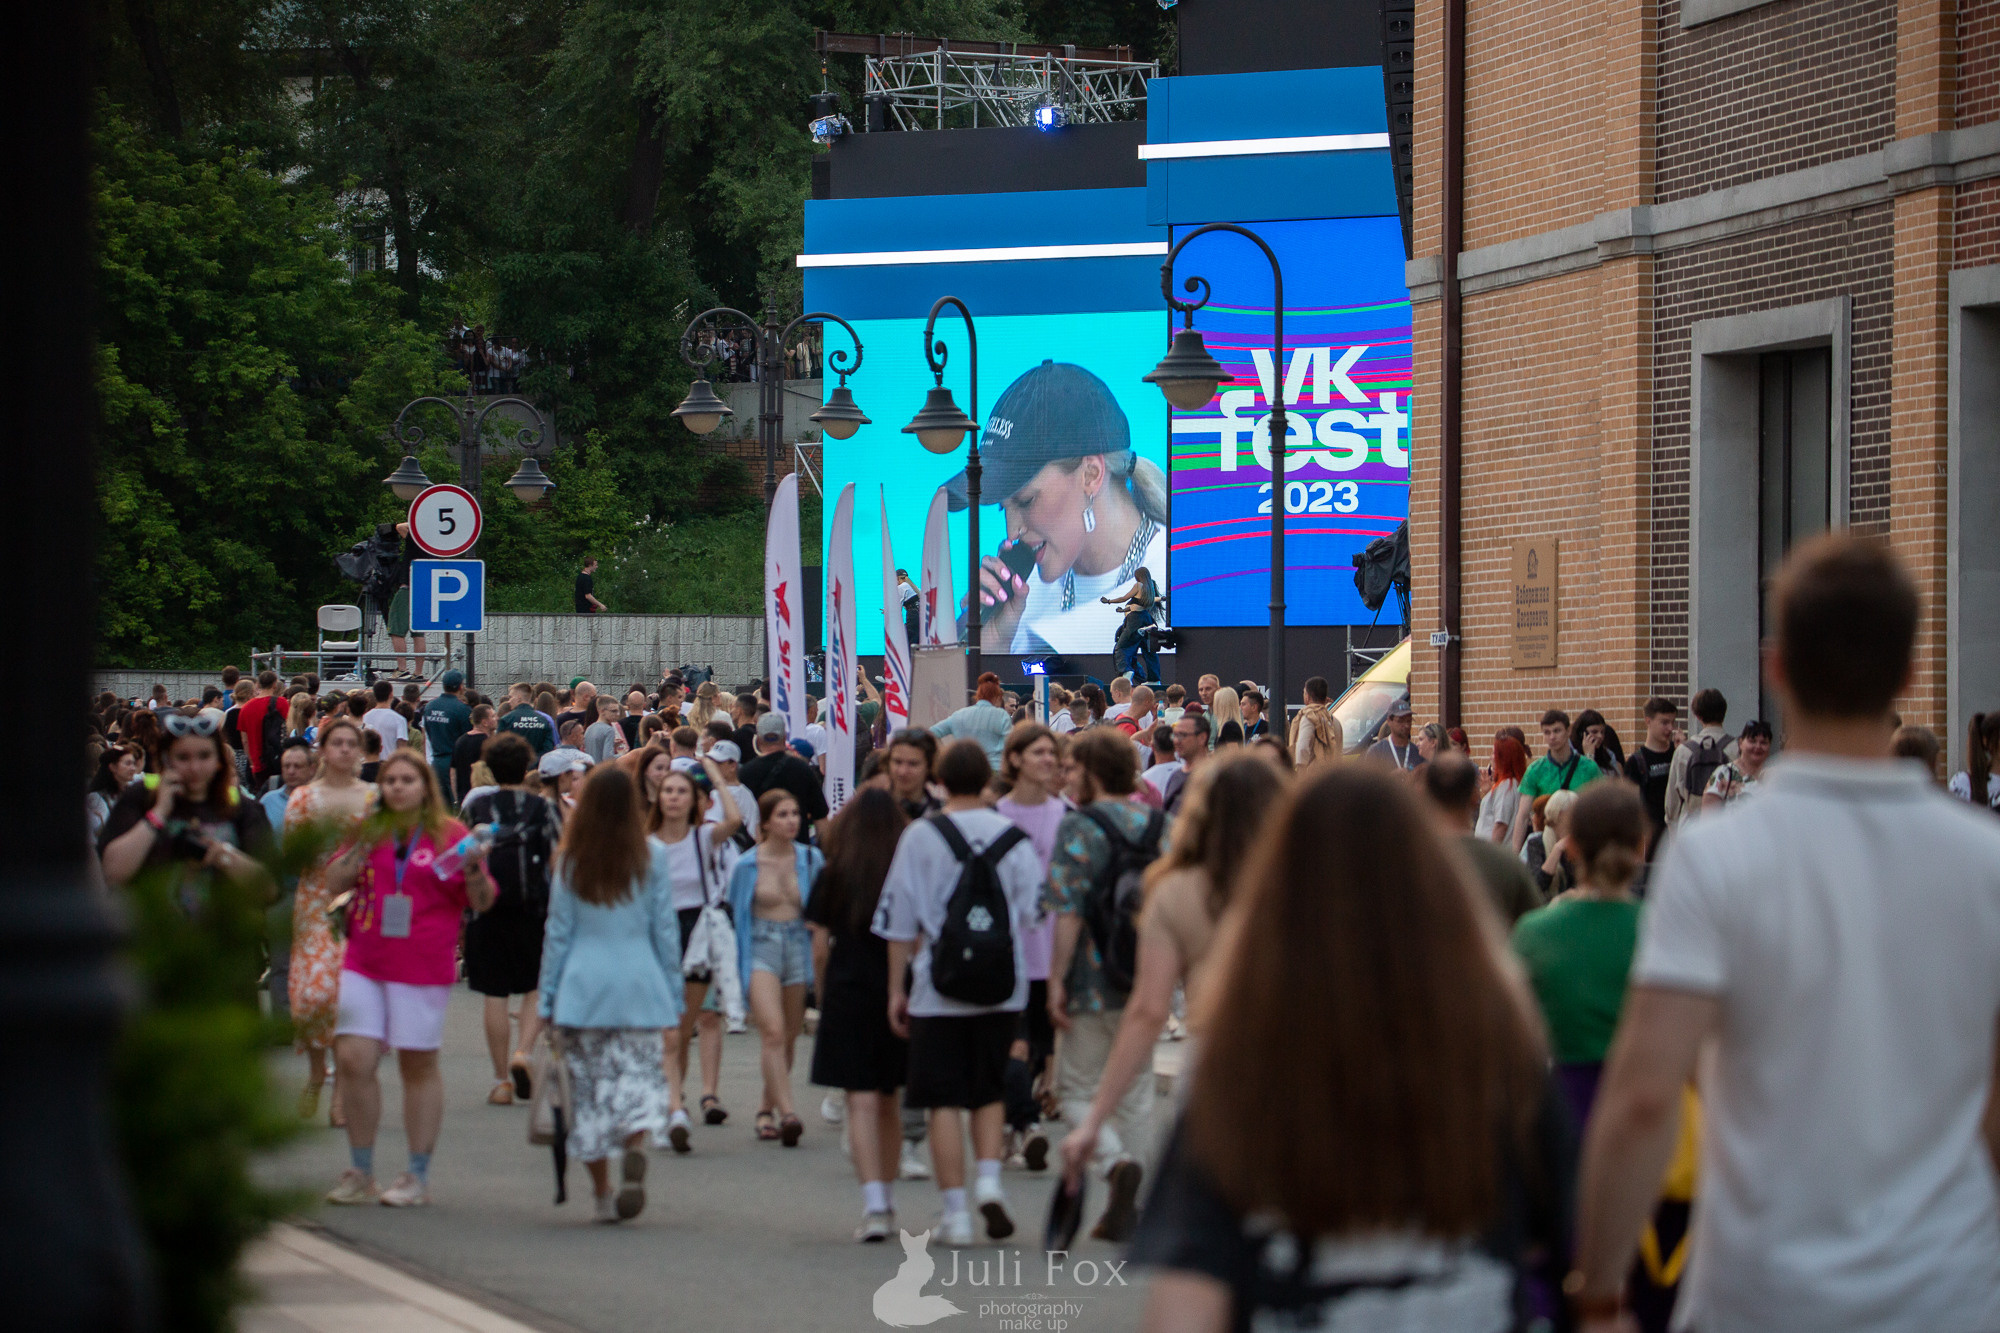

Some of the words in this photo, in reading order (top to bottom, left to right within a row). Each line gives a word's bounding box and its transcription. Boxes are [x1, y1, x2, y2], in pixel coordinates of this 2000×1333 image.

[1251, 346, 1371, 406] VK
[1172, 390, 1408, 473] fest
[1258, 481, 1359, 514] 2023
[438, 508, 456, 535] 5
[430, 569, 469, 622] P
[513, 721, 545, 729] РОССИИ
